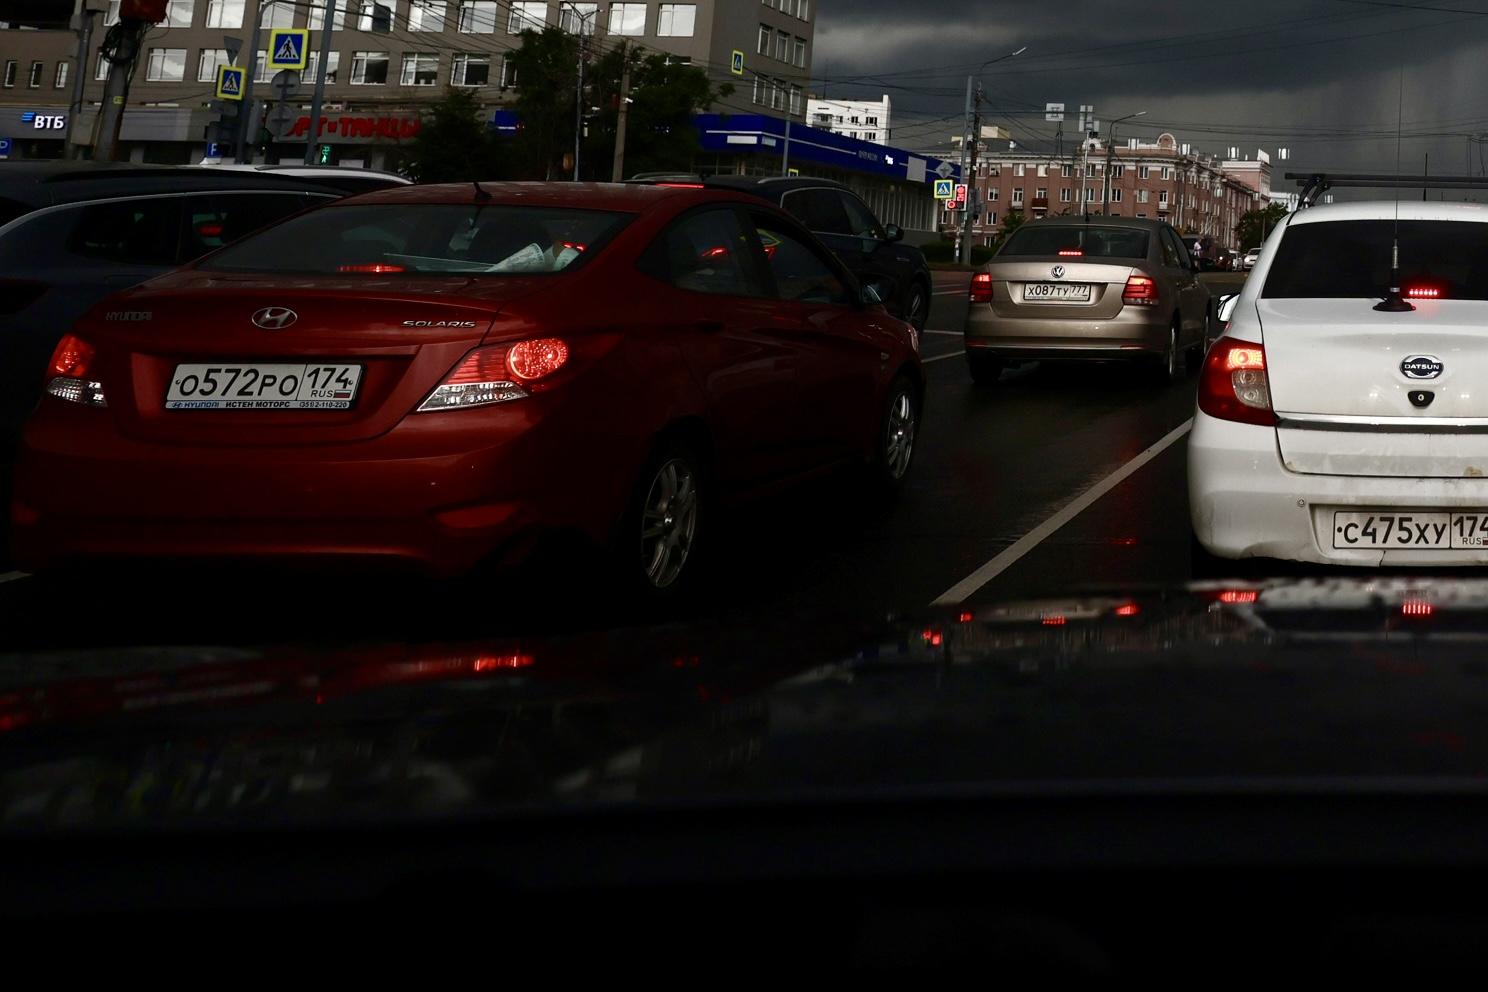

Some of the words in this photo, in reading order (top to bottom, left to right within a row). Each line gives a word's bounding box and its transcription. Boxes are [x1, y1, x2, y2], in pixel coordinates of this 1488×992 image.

[33, 115, 65, 129] ВТБ
[1071, 285, 1087, 294] 777
[402, 320, 476, 328] SOLARIS
[179, 368, 299, 397] О572РО
[307, 367, 350, 389] 174
[310, 390, 334, 398] RUS
[1343, 516, 1447, 545] С475ХУ
[1462, 537, 1482, 545] RUS
